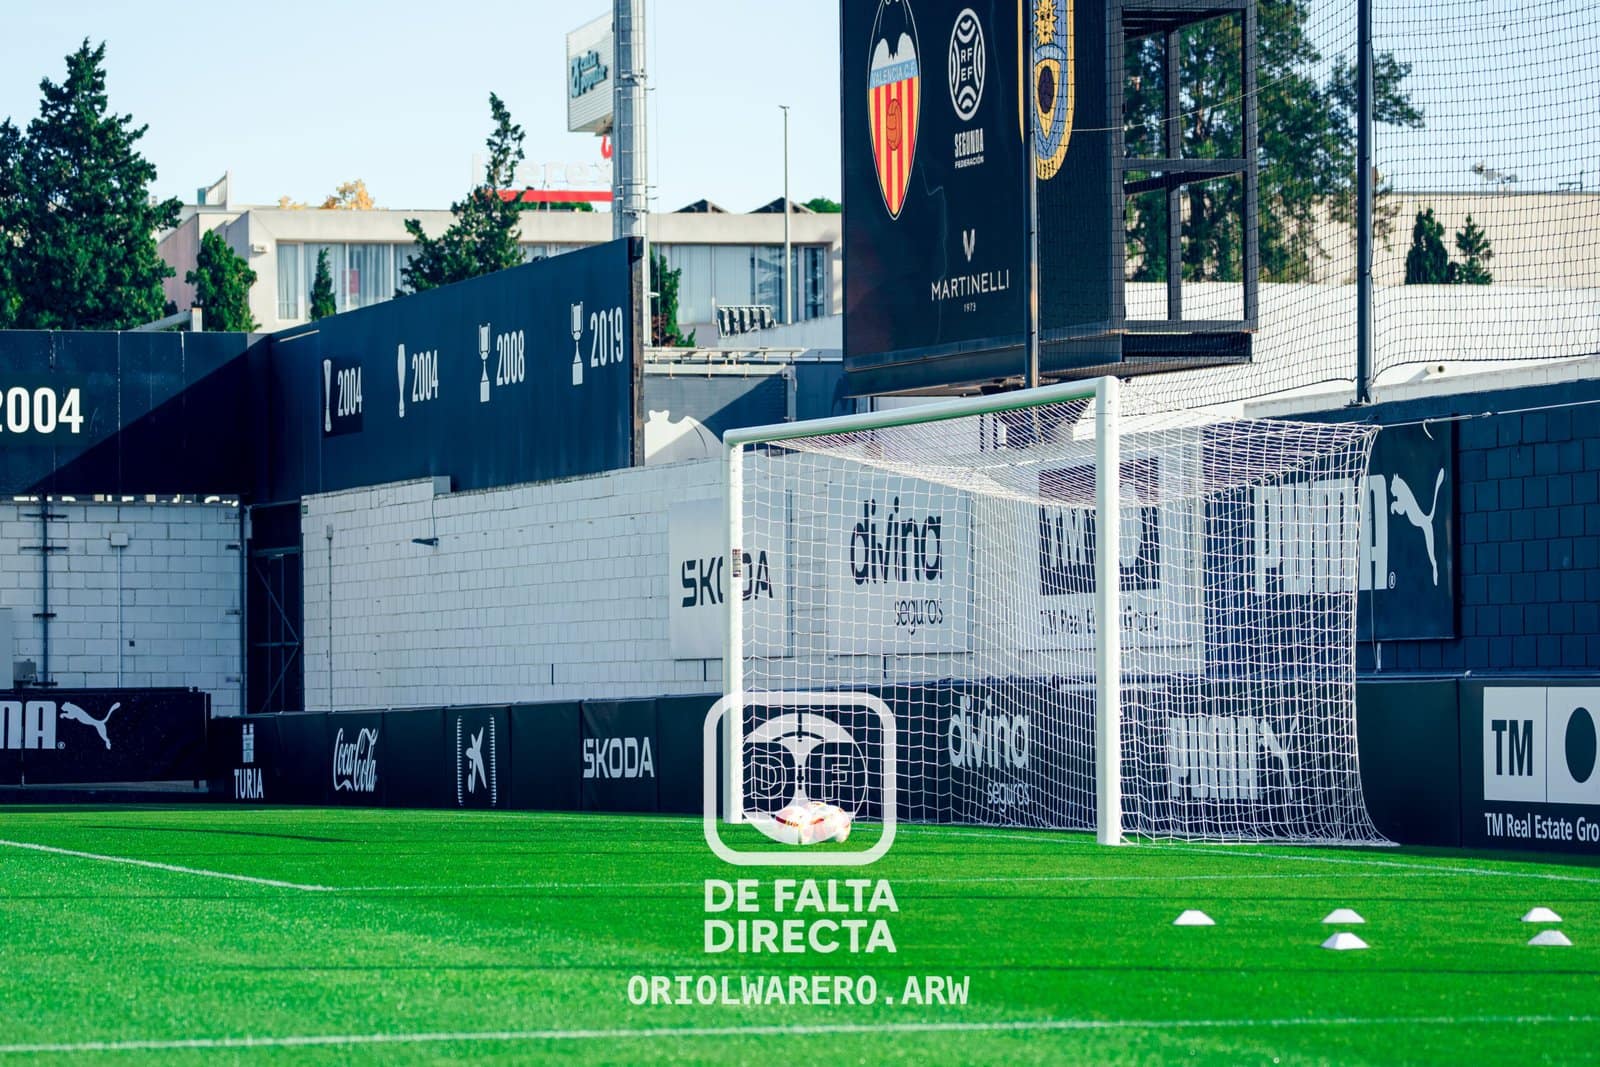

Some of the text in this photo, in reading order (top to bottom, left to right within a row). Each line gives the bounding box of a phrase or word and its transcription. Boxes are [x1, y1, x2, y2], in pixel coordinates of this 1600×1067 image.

[954, 127, 984, 158] SEGUNDA
[931, 268, 1009, 302] MARTINELLI
[963, 302, 976, 312] 1973
[496, 329, 525, 386] 2008
[590, 306, 624, 368] 2019
[337, 366, 363, 416] 2004
[412, 350, 439, 402] 2004
[0, 386, 84, 434] 004
[850, 496, 942, 585] divina
[1254, 474, 1388, 596] PUMA
[894, 600, 943, 635] seguros
[948, 694, 1029, 768] divina
[1491, 719, 1534, 777] TM
[234, 767, 264, 799] TURIA
[987, 783, 1029, 812] seguros
[1484, 812, 1503, 837] TM
[1506, 812, 1532, 839] Real
[1535, 815, 1573, 842] Estate
